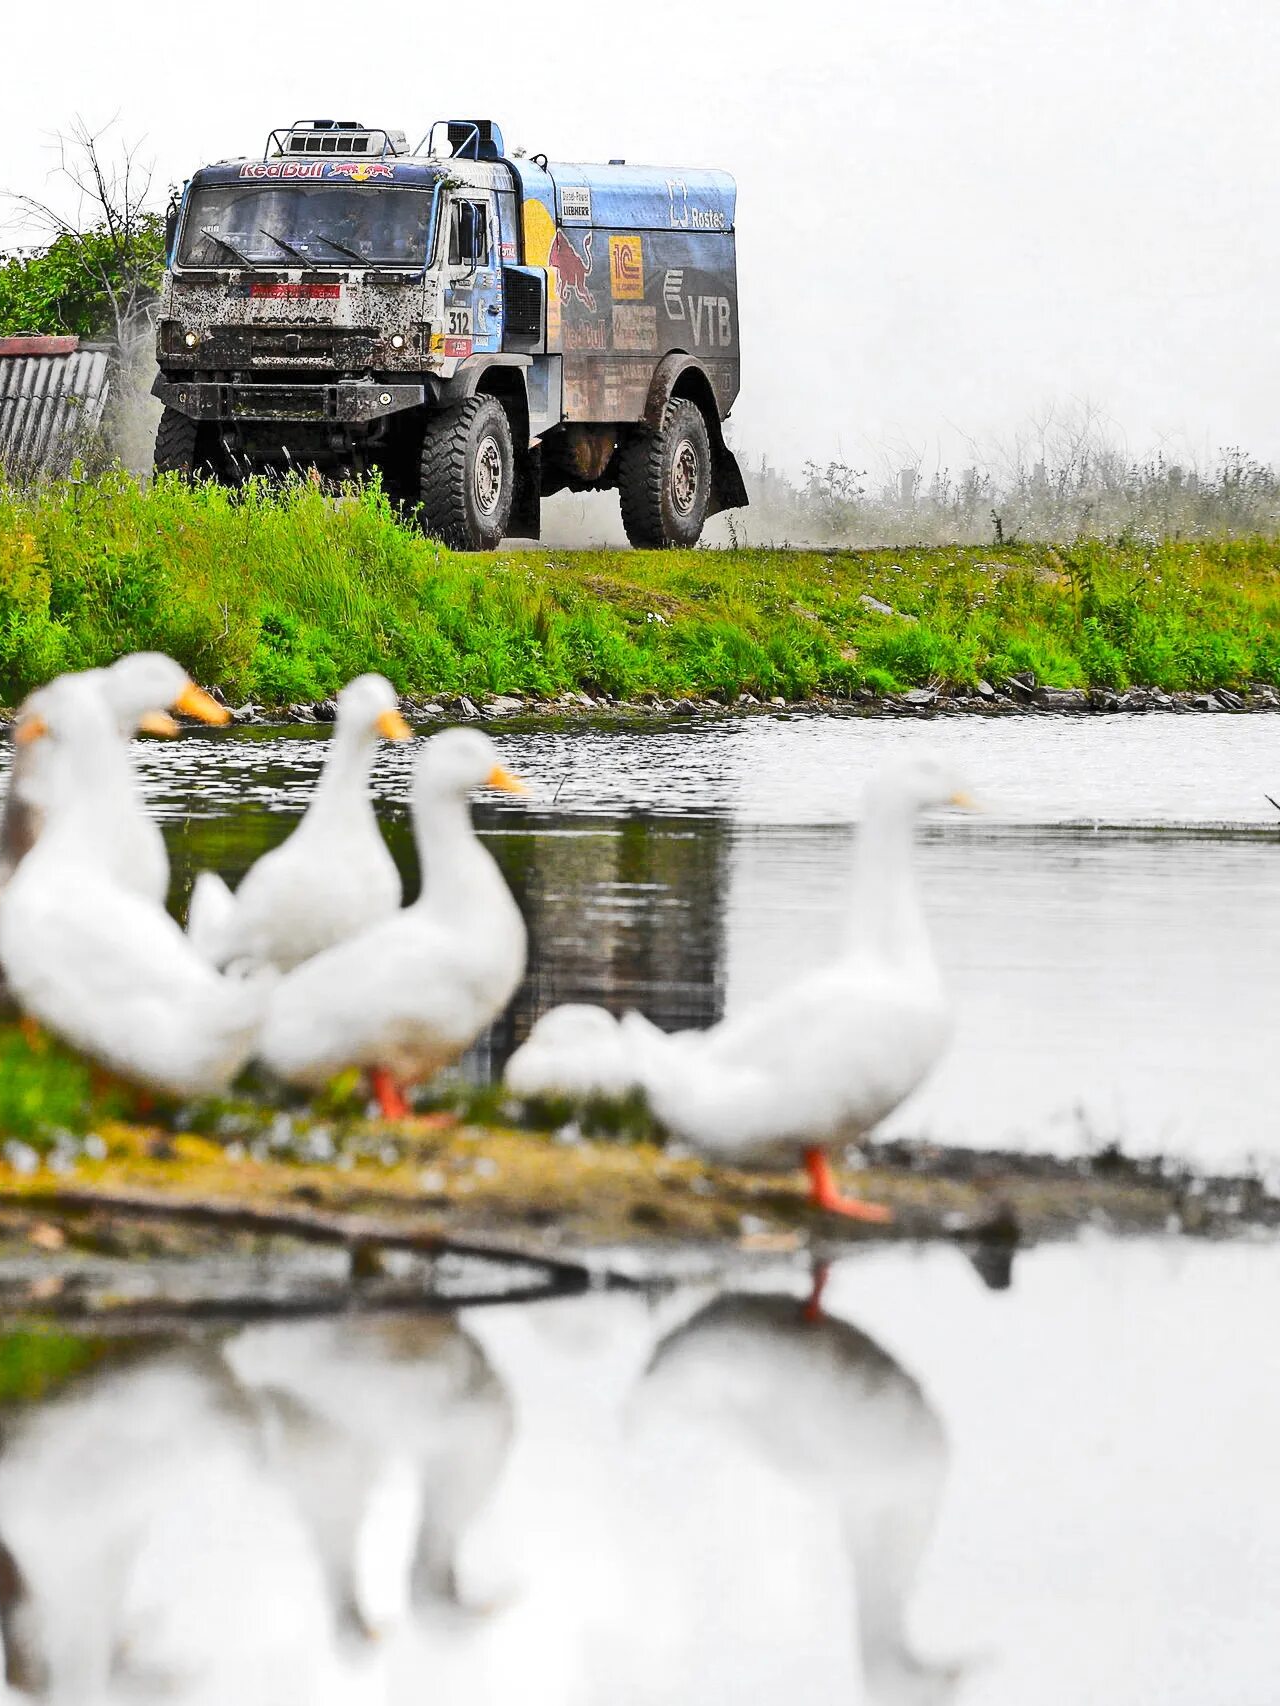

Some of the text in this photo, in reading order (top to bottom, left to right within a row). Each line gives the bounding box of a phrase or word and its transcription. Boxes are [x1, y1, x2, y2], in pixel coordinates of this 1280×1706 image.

[240, 162, 324, 178] Red Bull
[563, 205, 590, 216] LIEBHERR
[449, 311, 470, 335] 312
[687, 295, 732, 347] VTB
